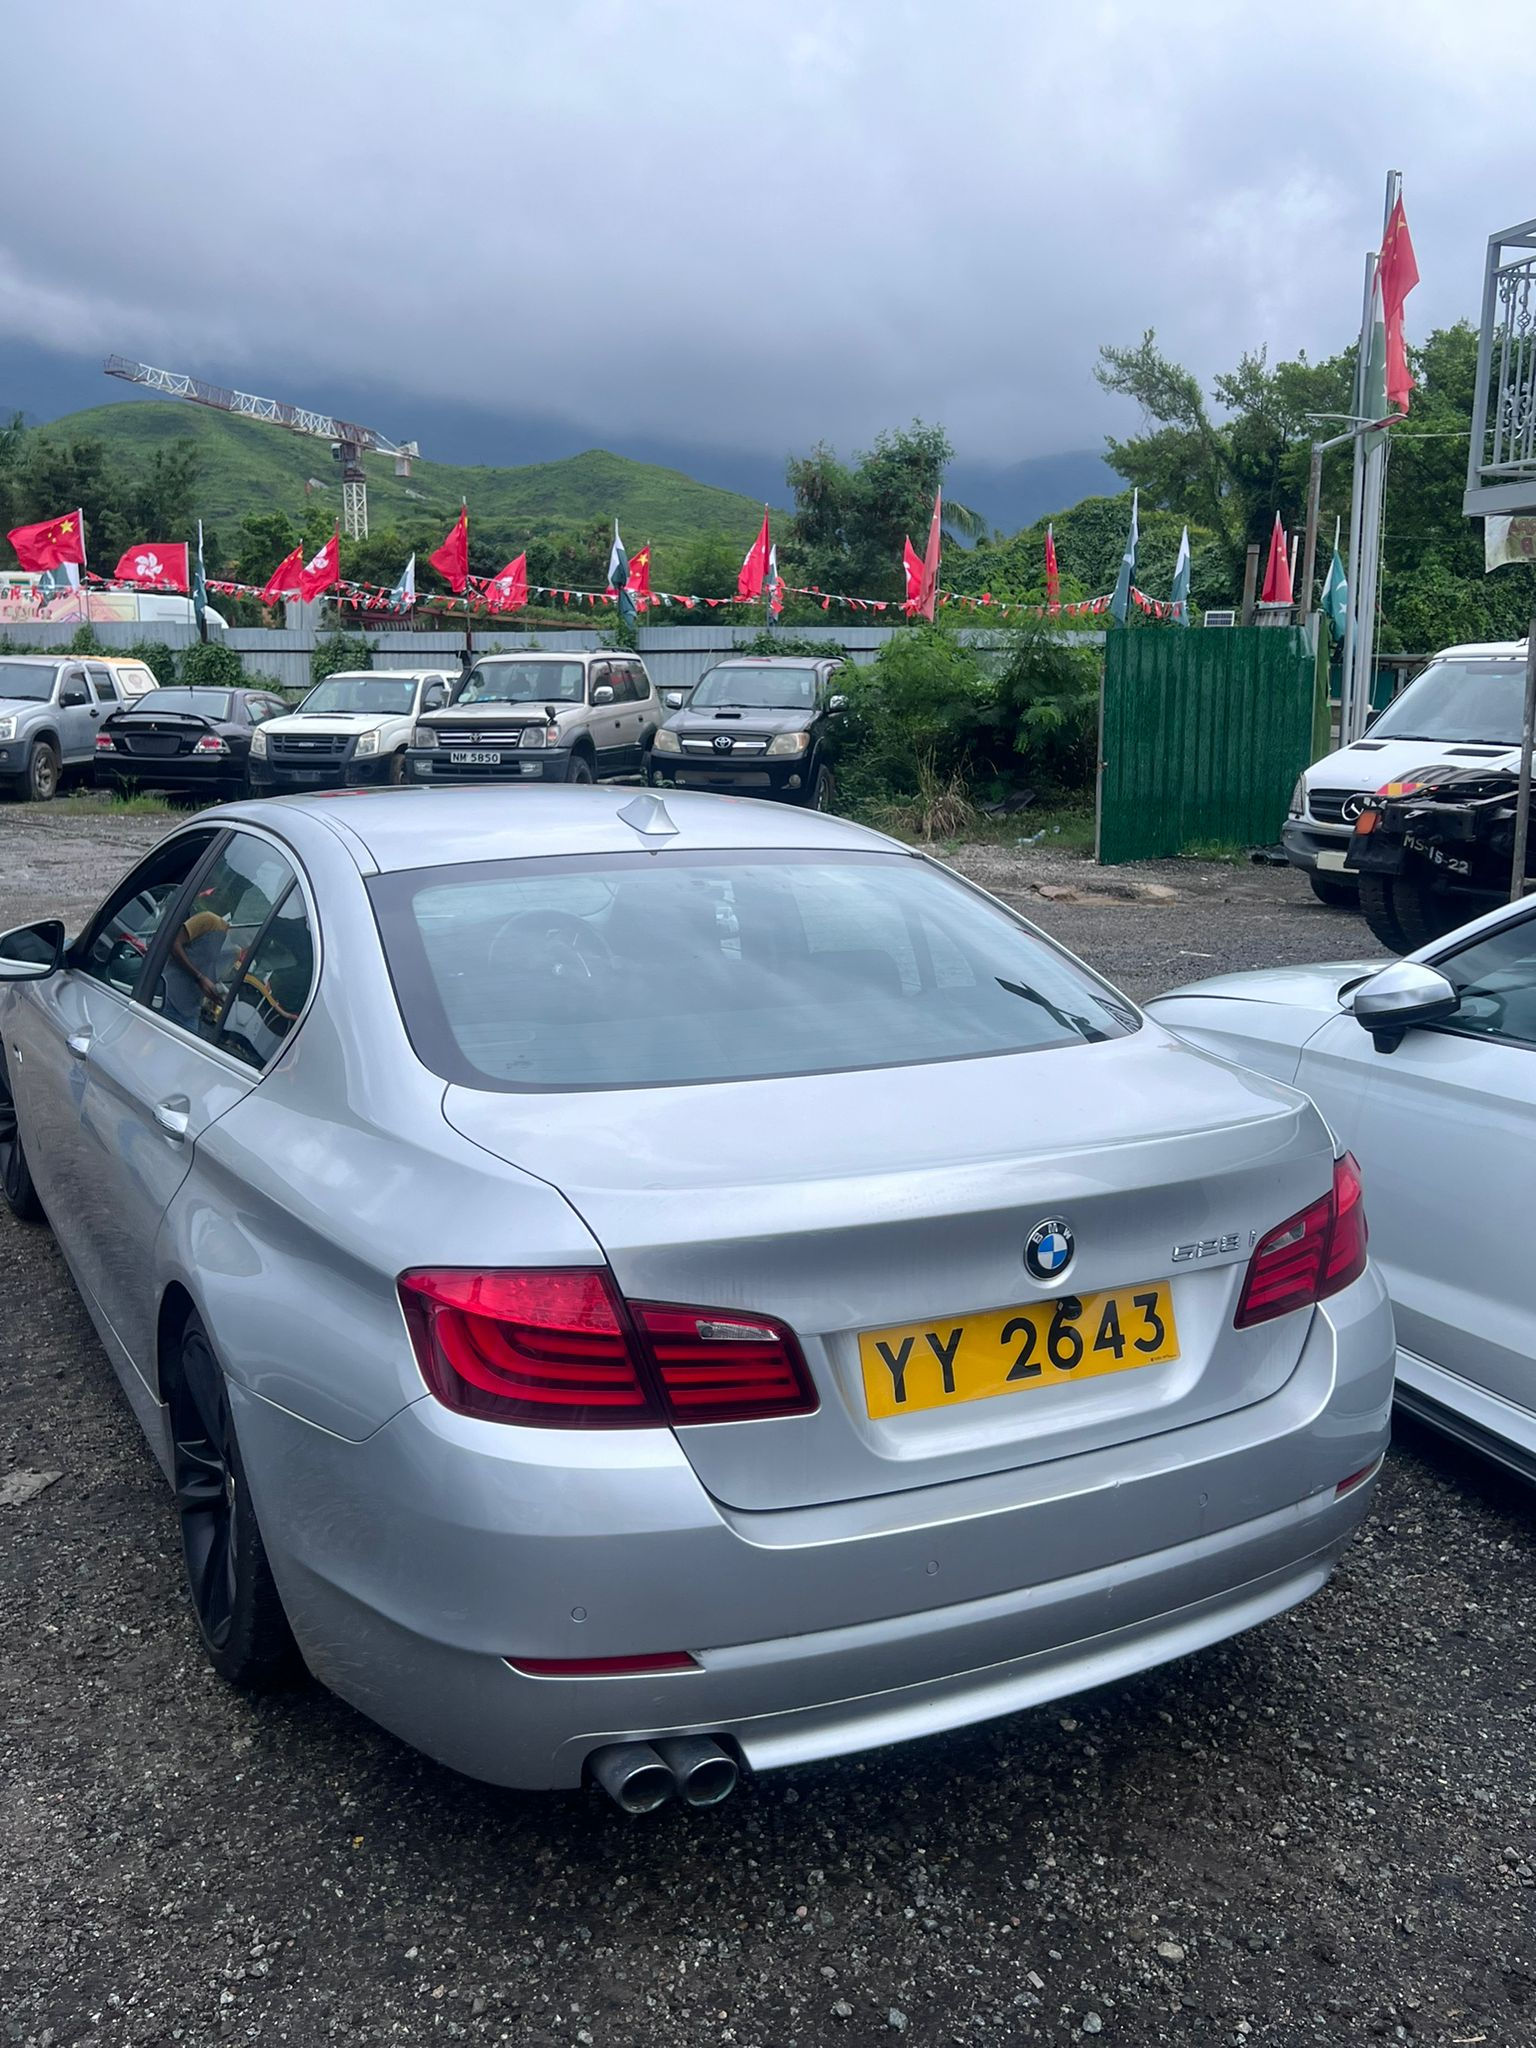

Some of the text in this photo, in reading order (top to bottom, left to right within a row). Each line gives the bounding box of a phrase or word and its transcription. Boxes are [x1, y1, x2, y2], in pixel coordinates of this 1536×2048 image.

[453, 753, 499, 763] NM 5850
[1032, 1222, 1072, 1244] BMW
[875, 1292, 1165, 1403] YY 2643
